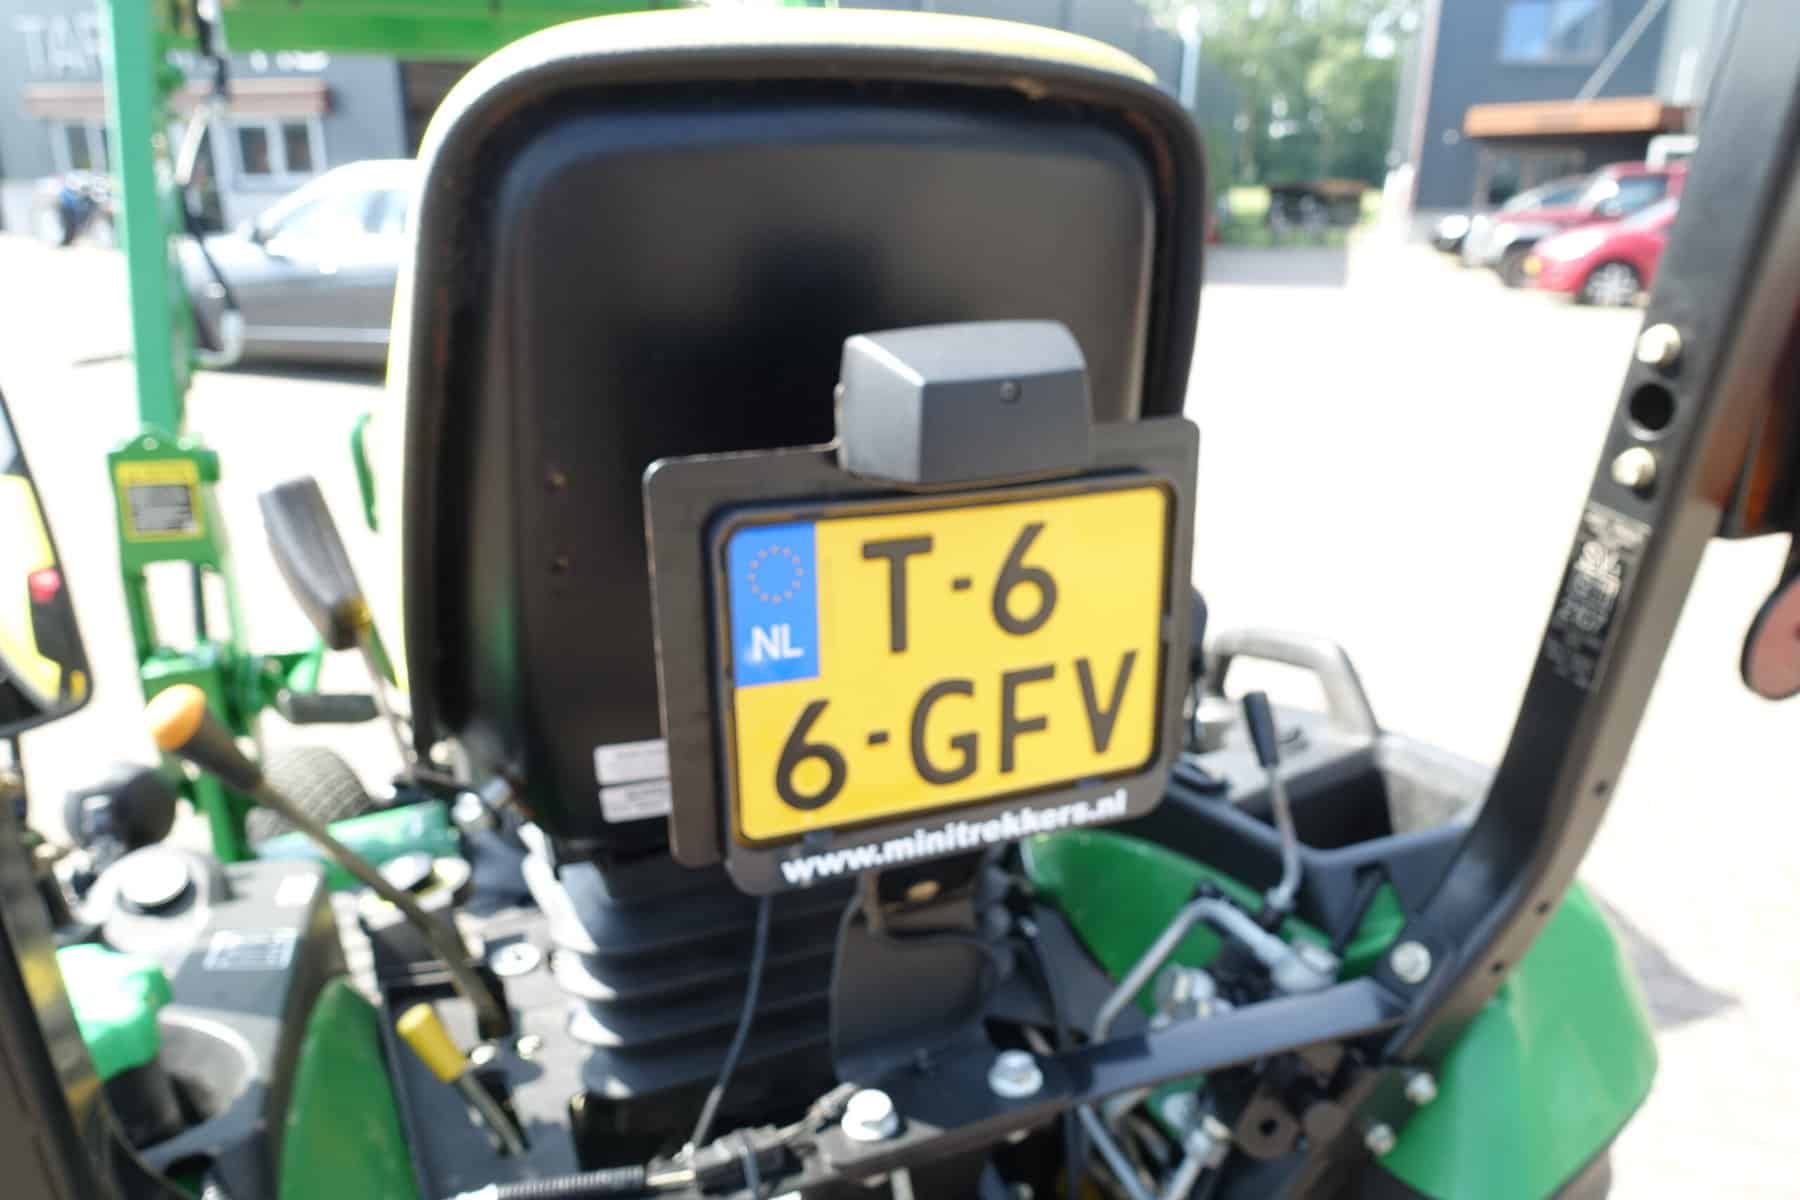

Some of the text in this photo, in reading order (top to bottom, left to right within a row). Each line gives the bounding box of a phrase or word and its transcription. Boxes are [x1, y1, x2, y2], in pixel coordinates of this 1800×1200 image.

[750, 623, 803, 660] NL
[861, 521, 1058, 653] T-6
[775, 651, 1138, 811] 6-GFV
[781, 788, 1127, 884] www.minitrekkers.nl
